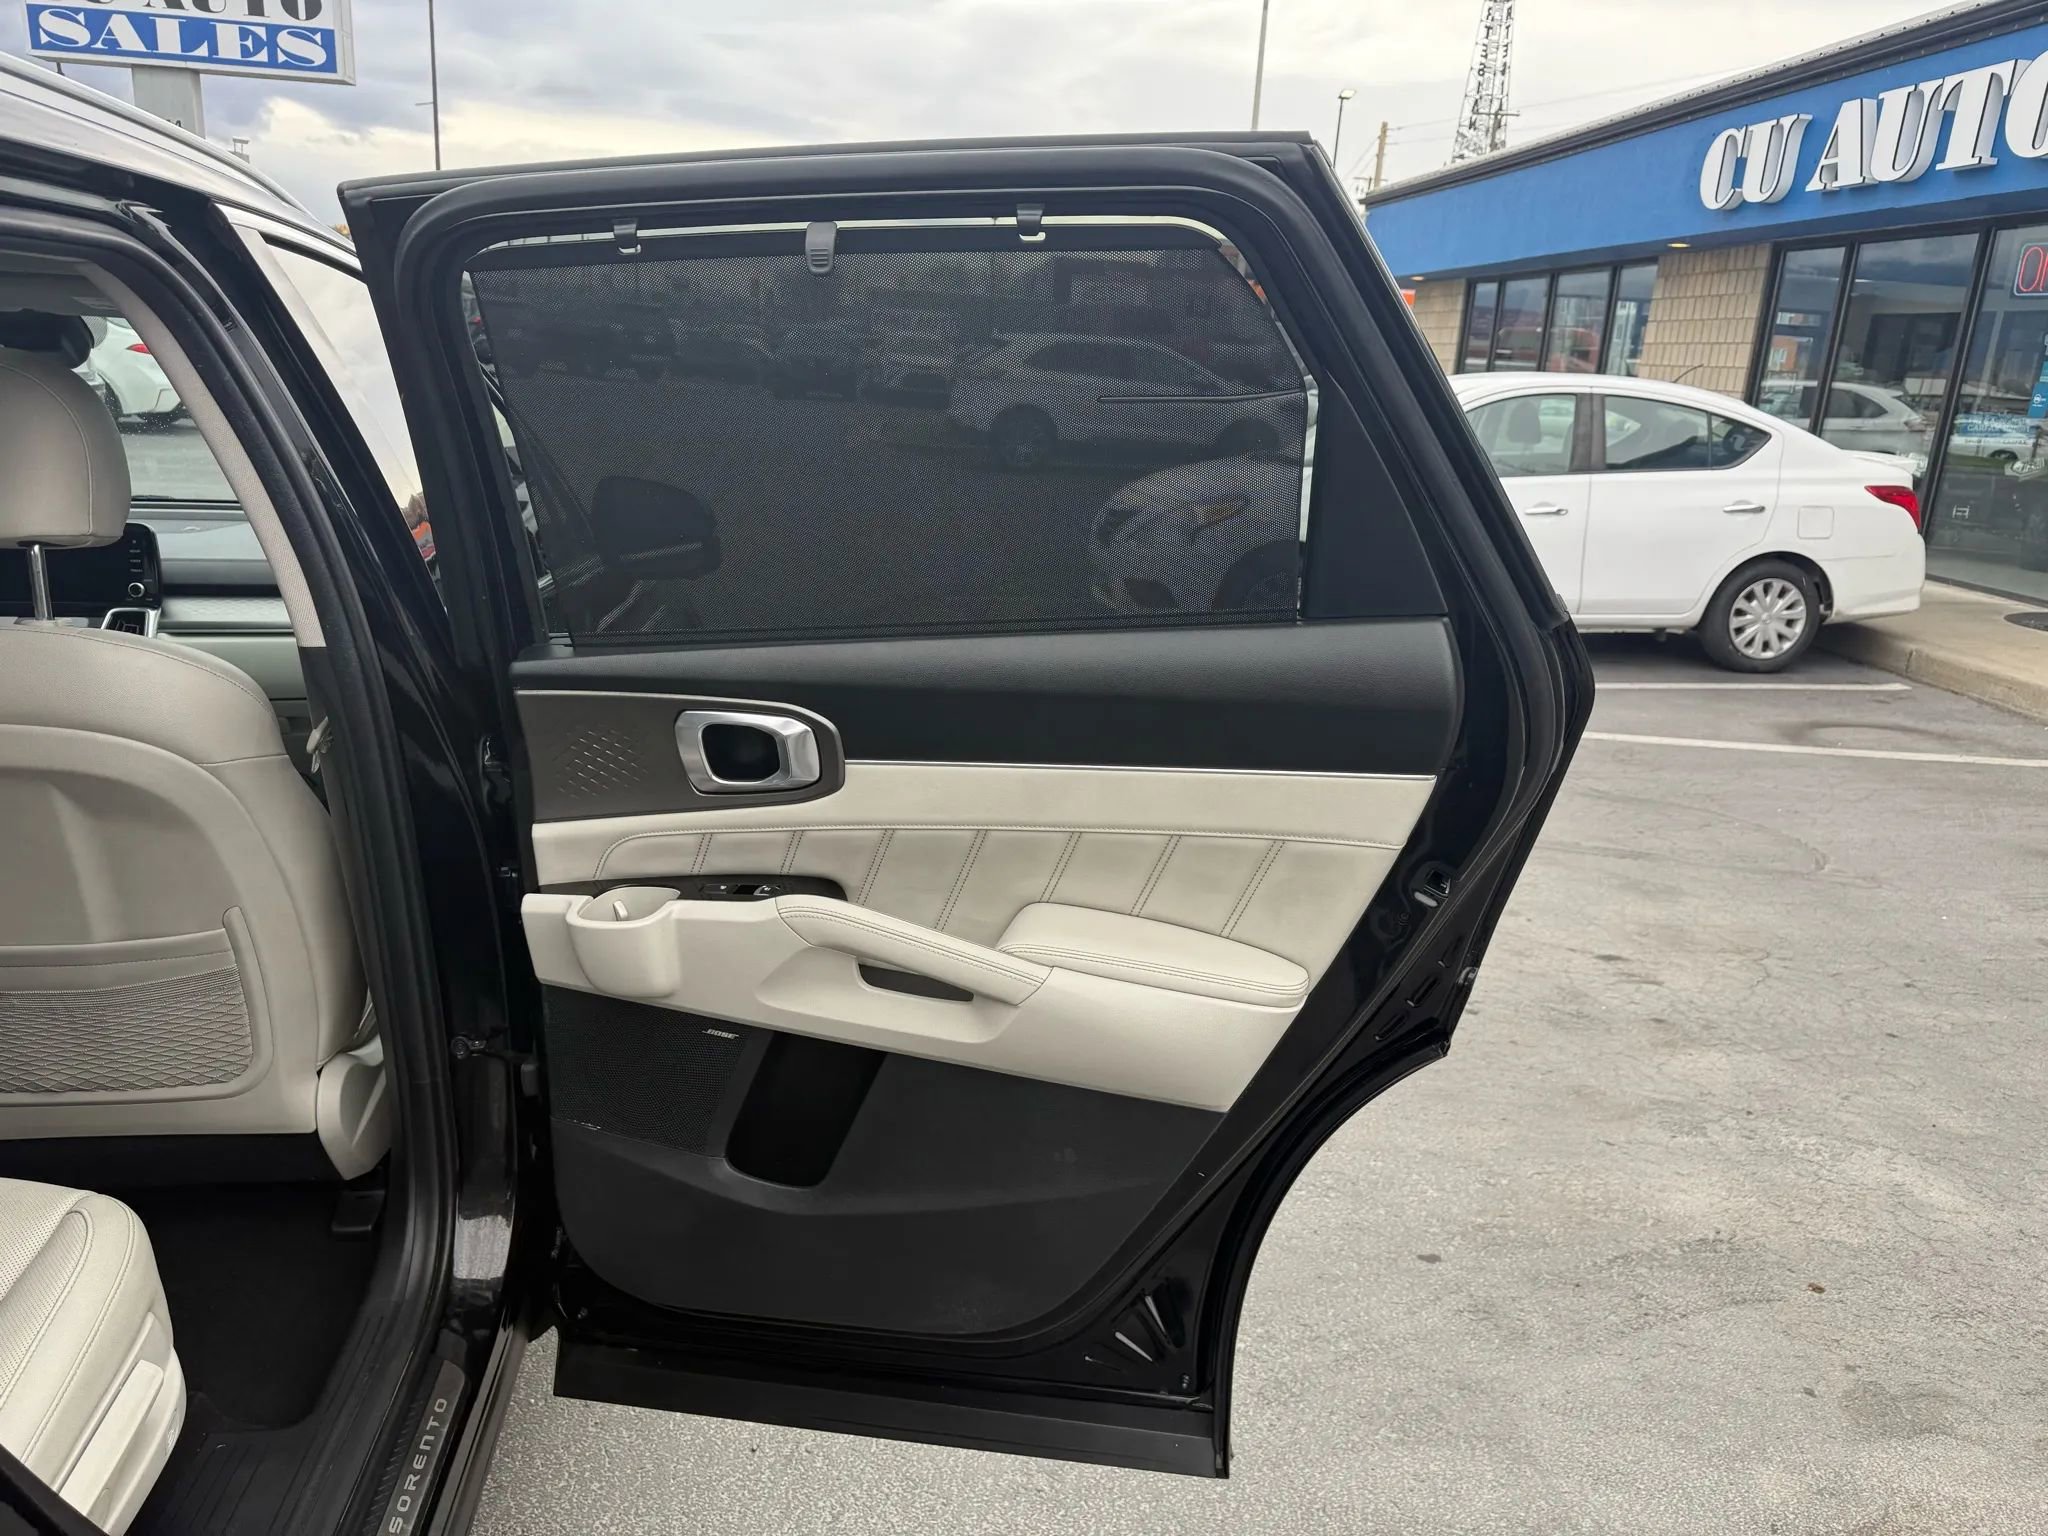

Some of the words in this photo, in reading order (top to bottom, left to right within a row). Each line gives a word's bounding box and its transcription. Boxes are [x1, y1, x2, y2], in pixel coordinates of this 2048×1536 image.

[38, 8, 328, 67] SALES
[1700, 113, 1813, 211] CU
[702, 1029, 739, 1039] BOSE
[388, 1398, 448, 1535] SORENTO
